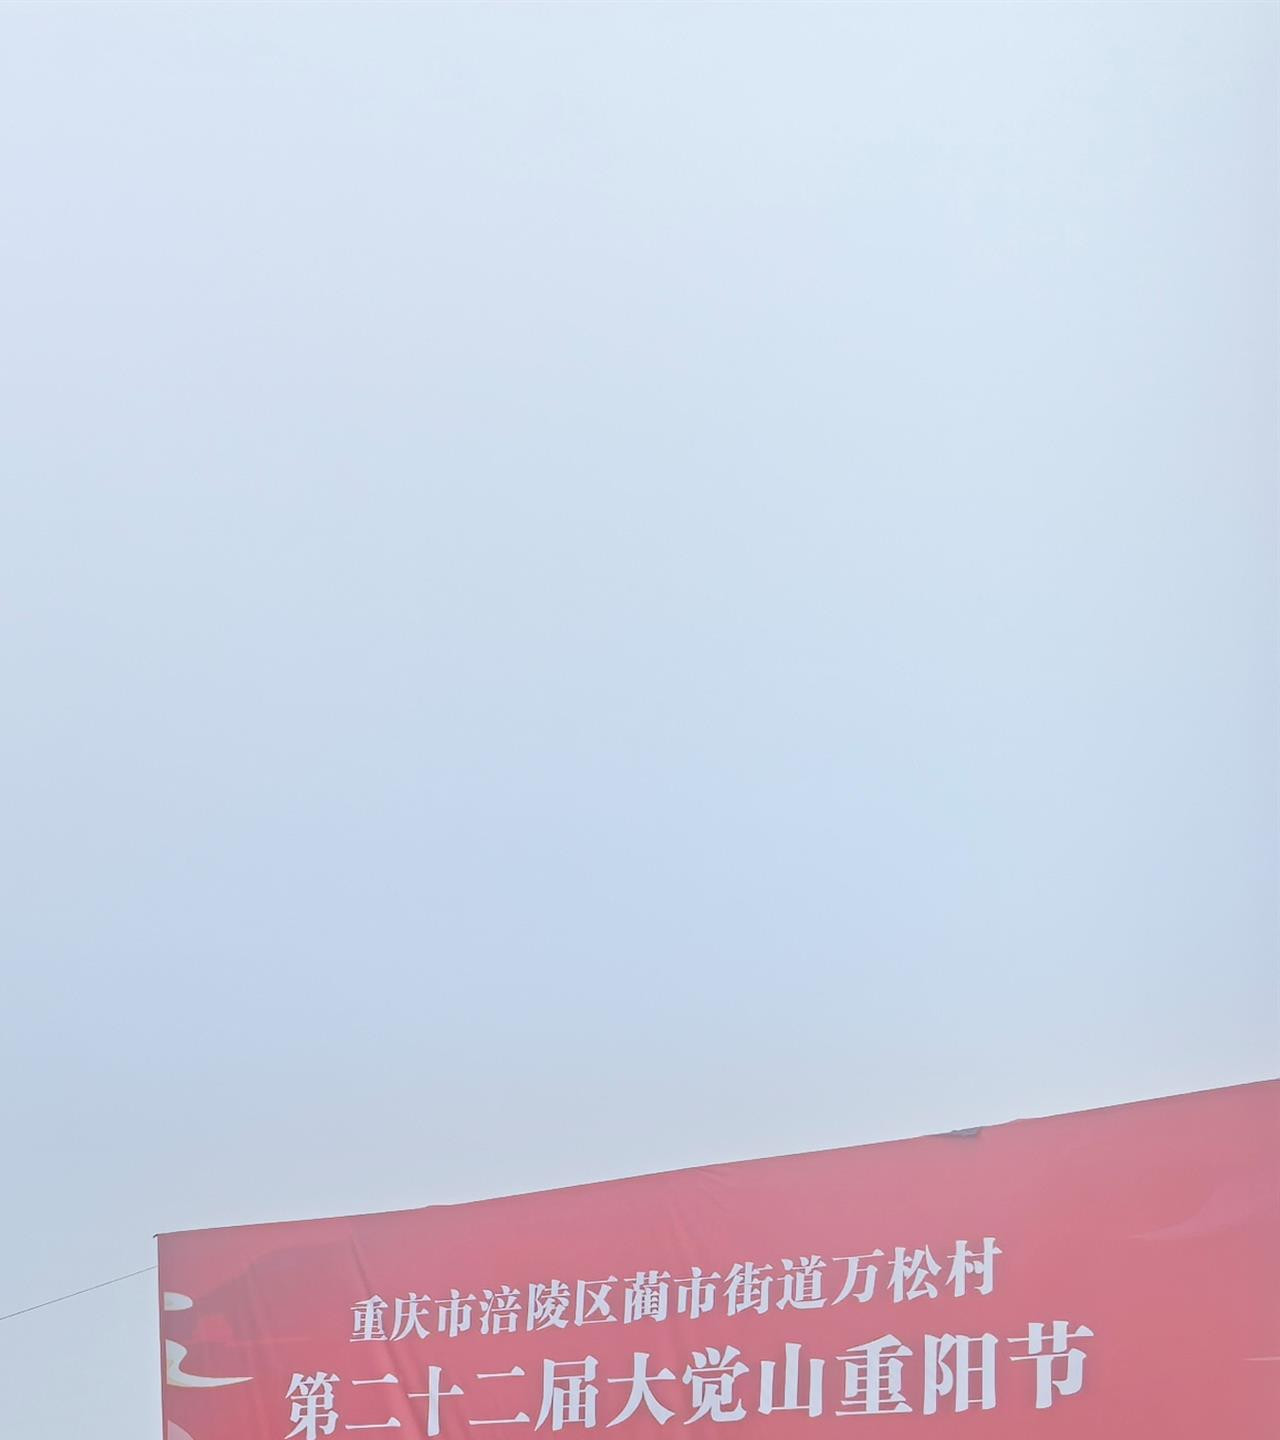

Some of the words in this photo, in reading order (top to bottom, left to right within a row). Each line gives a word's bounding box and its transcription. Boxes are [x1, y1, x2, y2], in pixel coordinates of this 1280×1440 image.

[350, 1237, 1002, 1342] 重庆市涪陵区蔺市街道万松村
[284, 1321, 1094, 1440] 第二十二届大觉山重阳节
